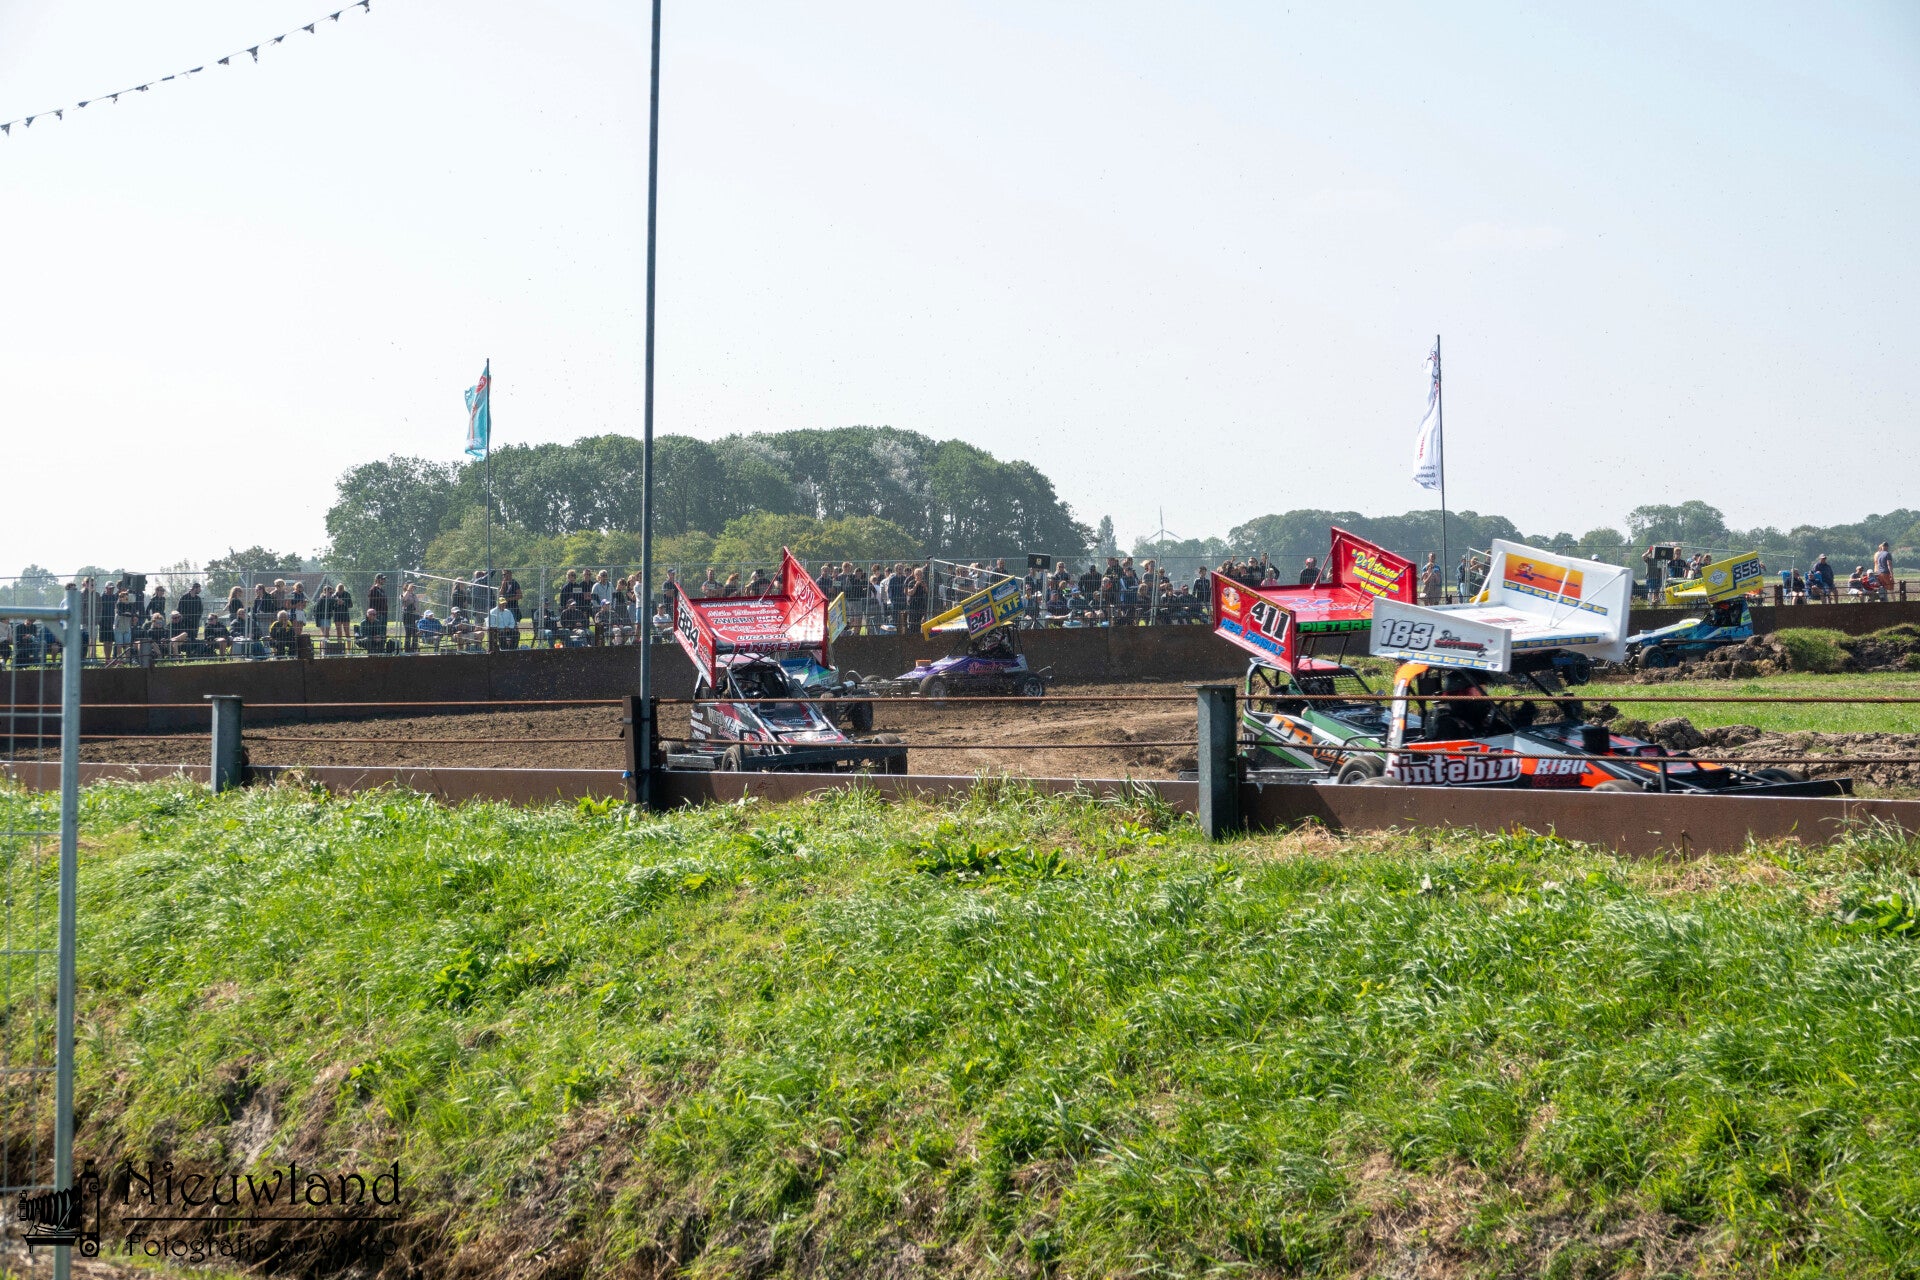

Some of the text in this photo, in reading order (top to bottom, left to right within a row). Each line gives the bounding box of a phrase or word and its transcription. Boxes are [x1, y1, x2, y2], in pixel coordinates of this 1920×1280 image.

[1733, 559, 1760, 581] 858
[969, 606, 993, 633] 241
[996, 595, 1020, 617] KTF
[677, 607, 700, 651] 884
[1250, 600, 1291, 643] 411
[1381, 619, 1435, 651] 183
